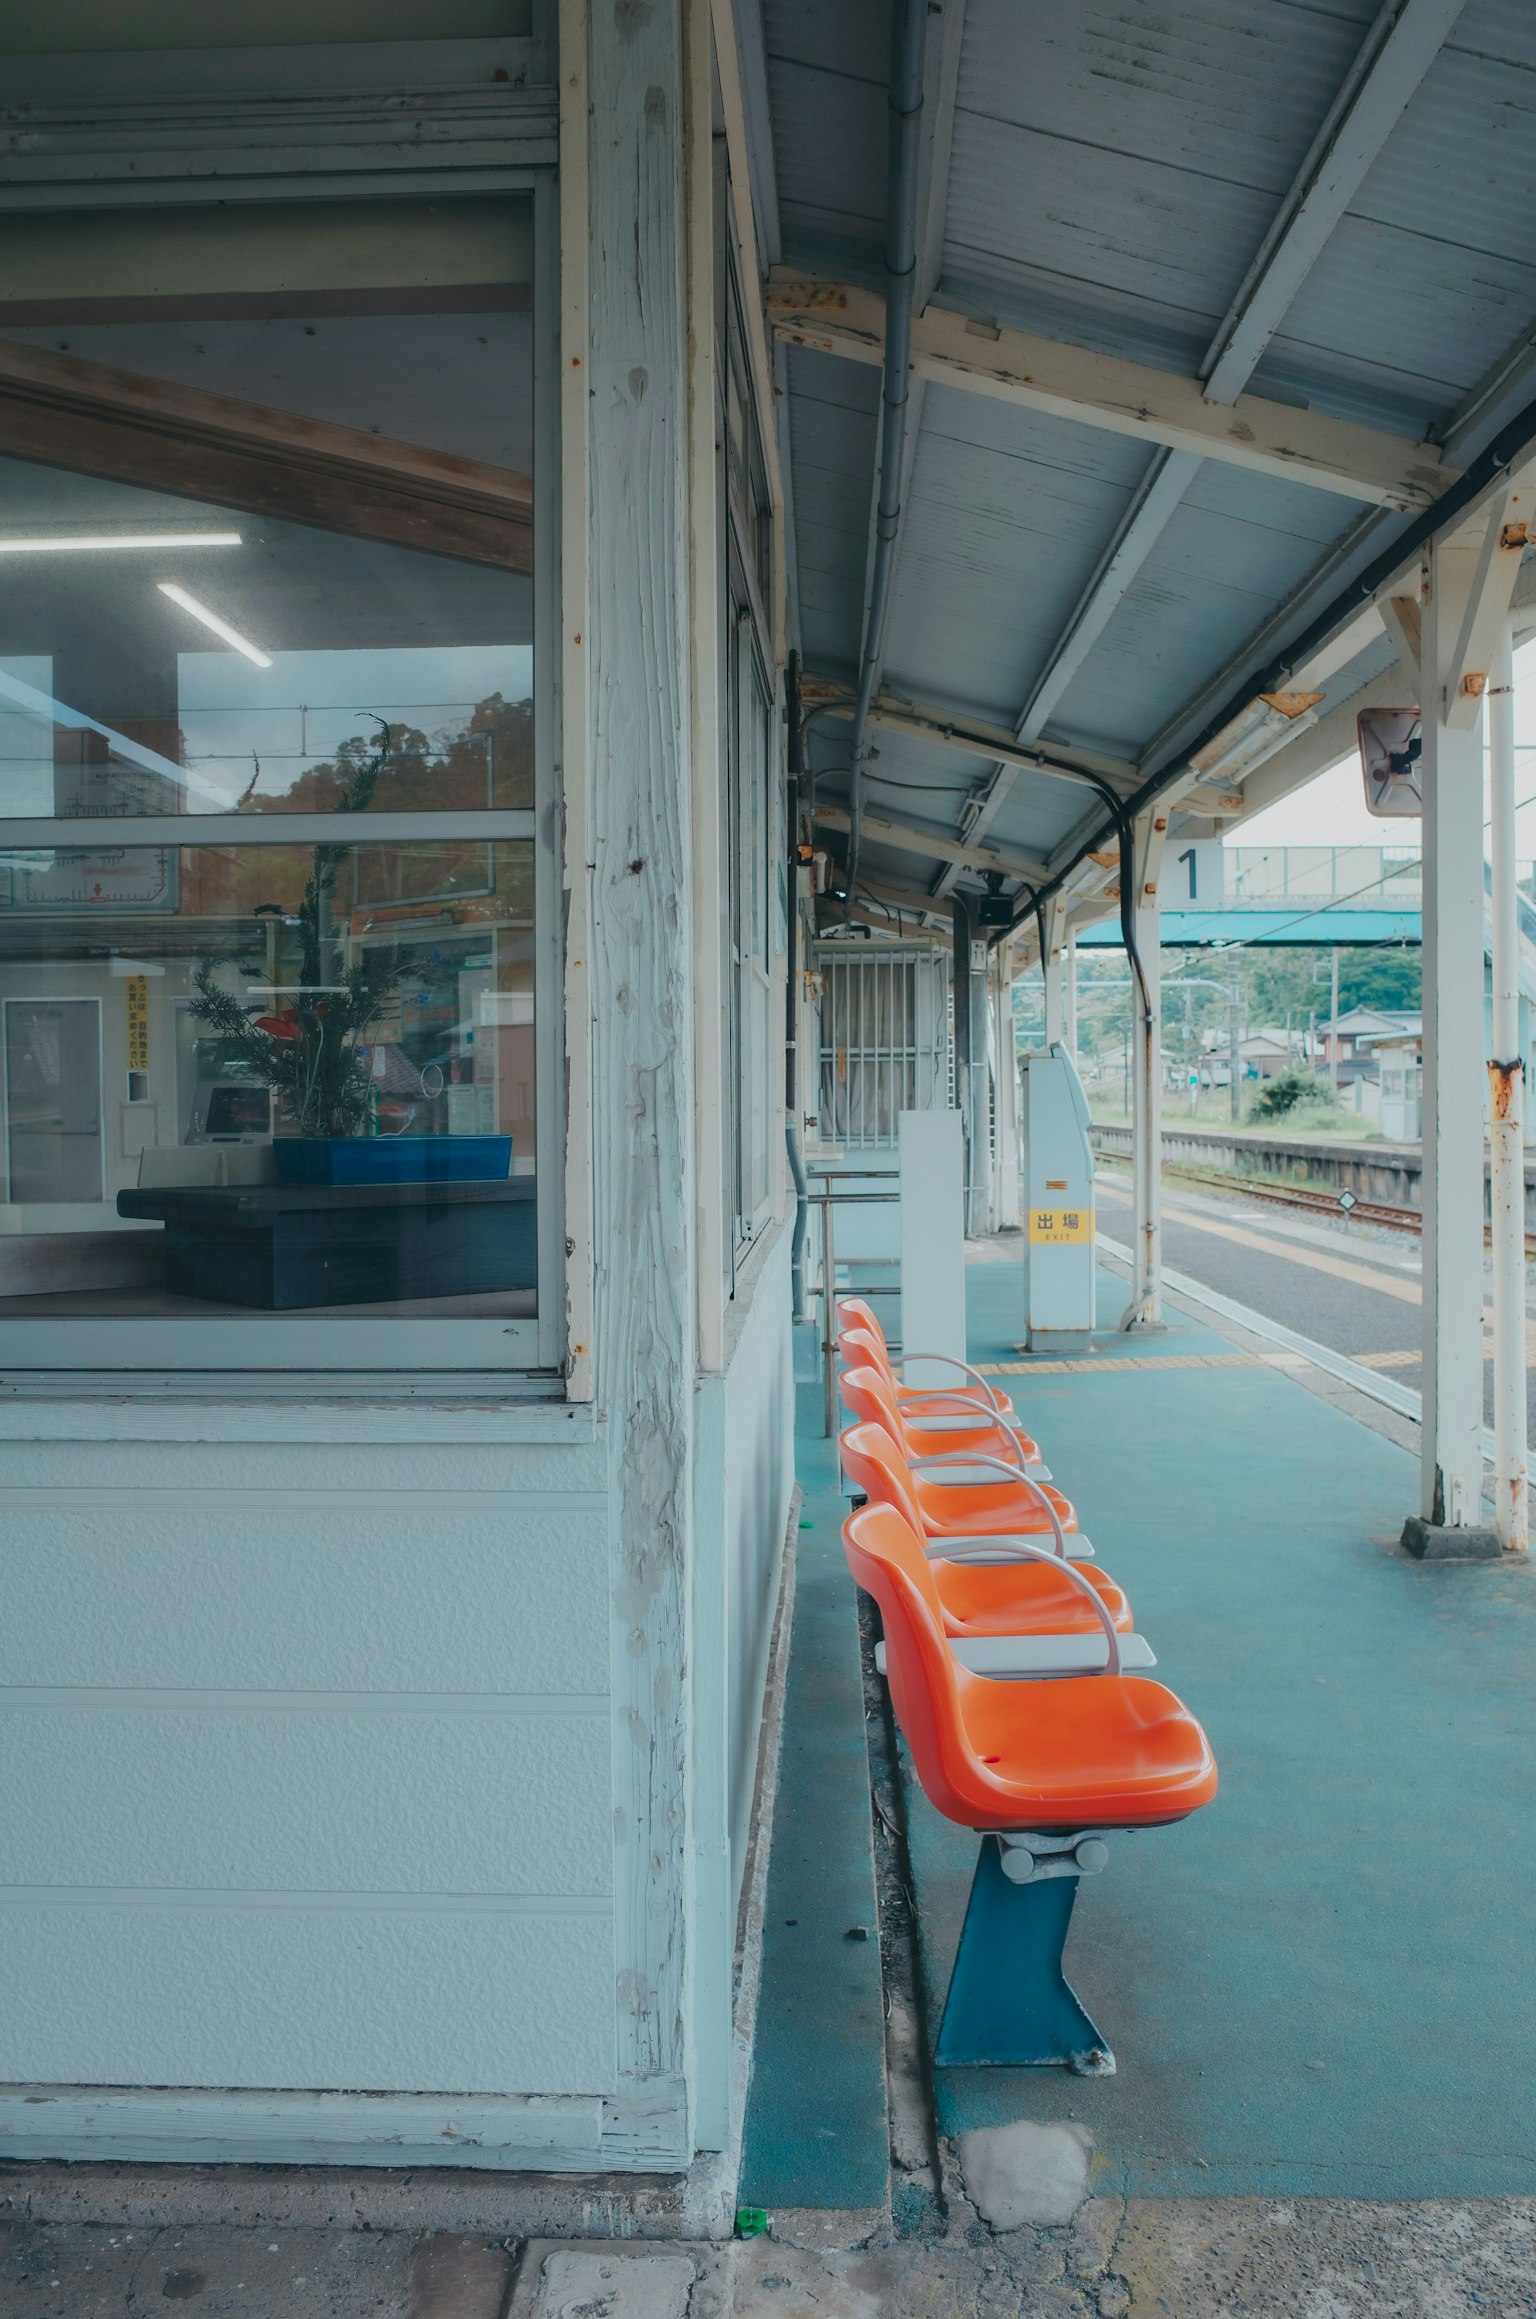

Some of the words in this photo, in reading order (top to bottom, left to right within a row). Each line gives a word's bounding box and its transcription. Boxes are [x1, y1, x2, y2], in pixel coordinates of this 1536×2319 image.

[1178, 848, 1197, 899] 1
[1037, 1213, 1079, 1230] 出場
[1045, 1233, 1070, 1241] EXIT
